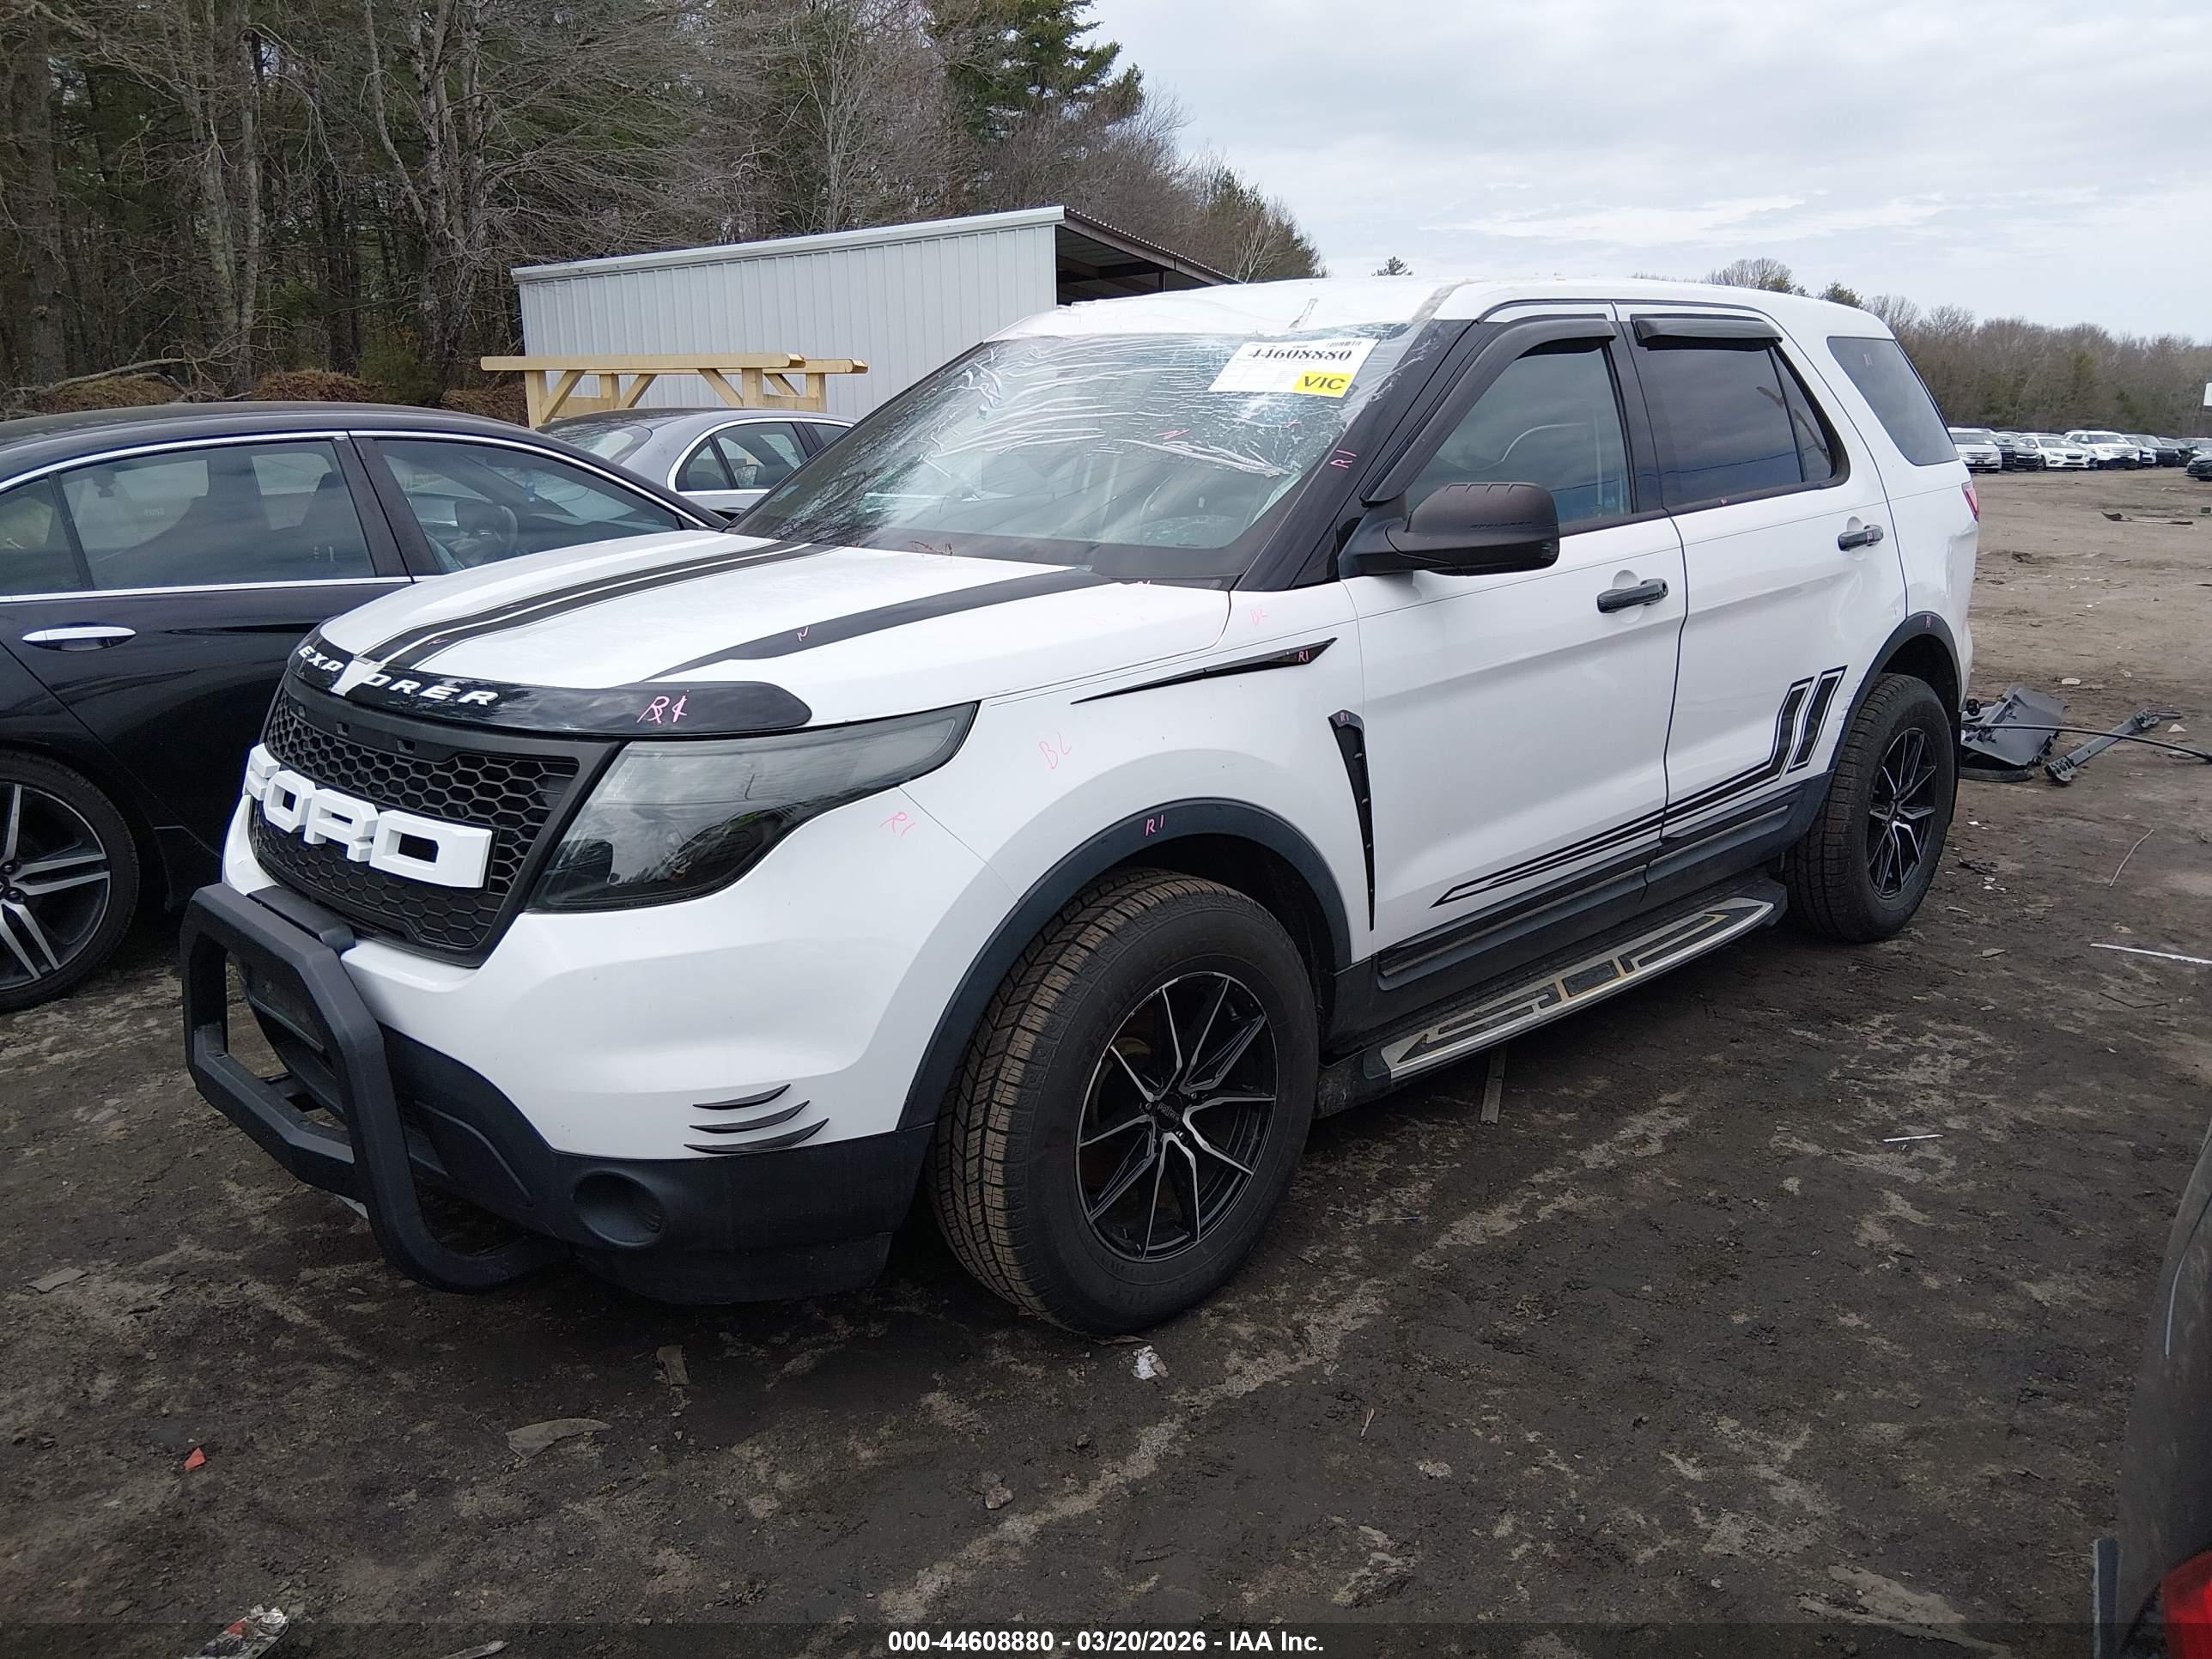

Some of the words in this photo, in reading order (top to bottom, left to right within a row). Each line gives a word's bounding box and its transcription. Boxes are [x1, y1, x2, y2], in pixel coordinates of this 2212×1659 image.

[1248, 348, 1352, 361] 44608880
[1304, 375, 1346, 390] VIC
[297, 645, 500, 706] EXPORER
[243, 742, 493, 889] FORD
